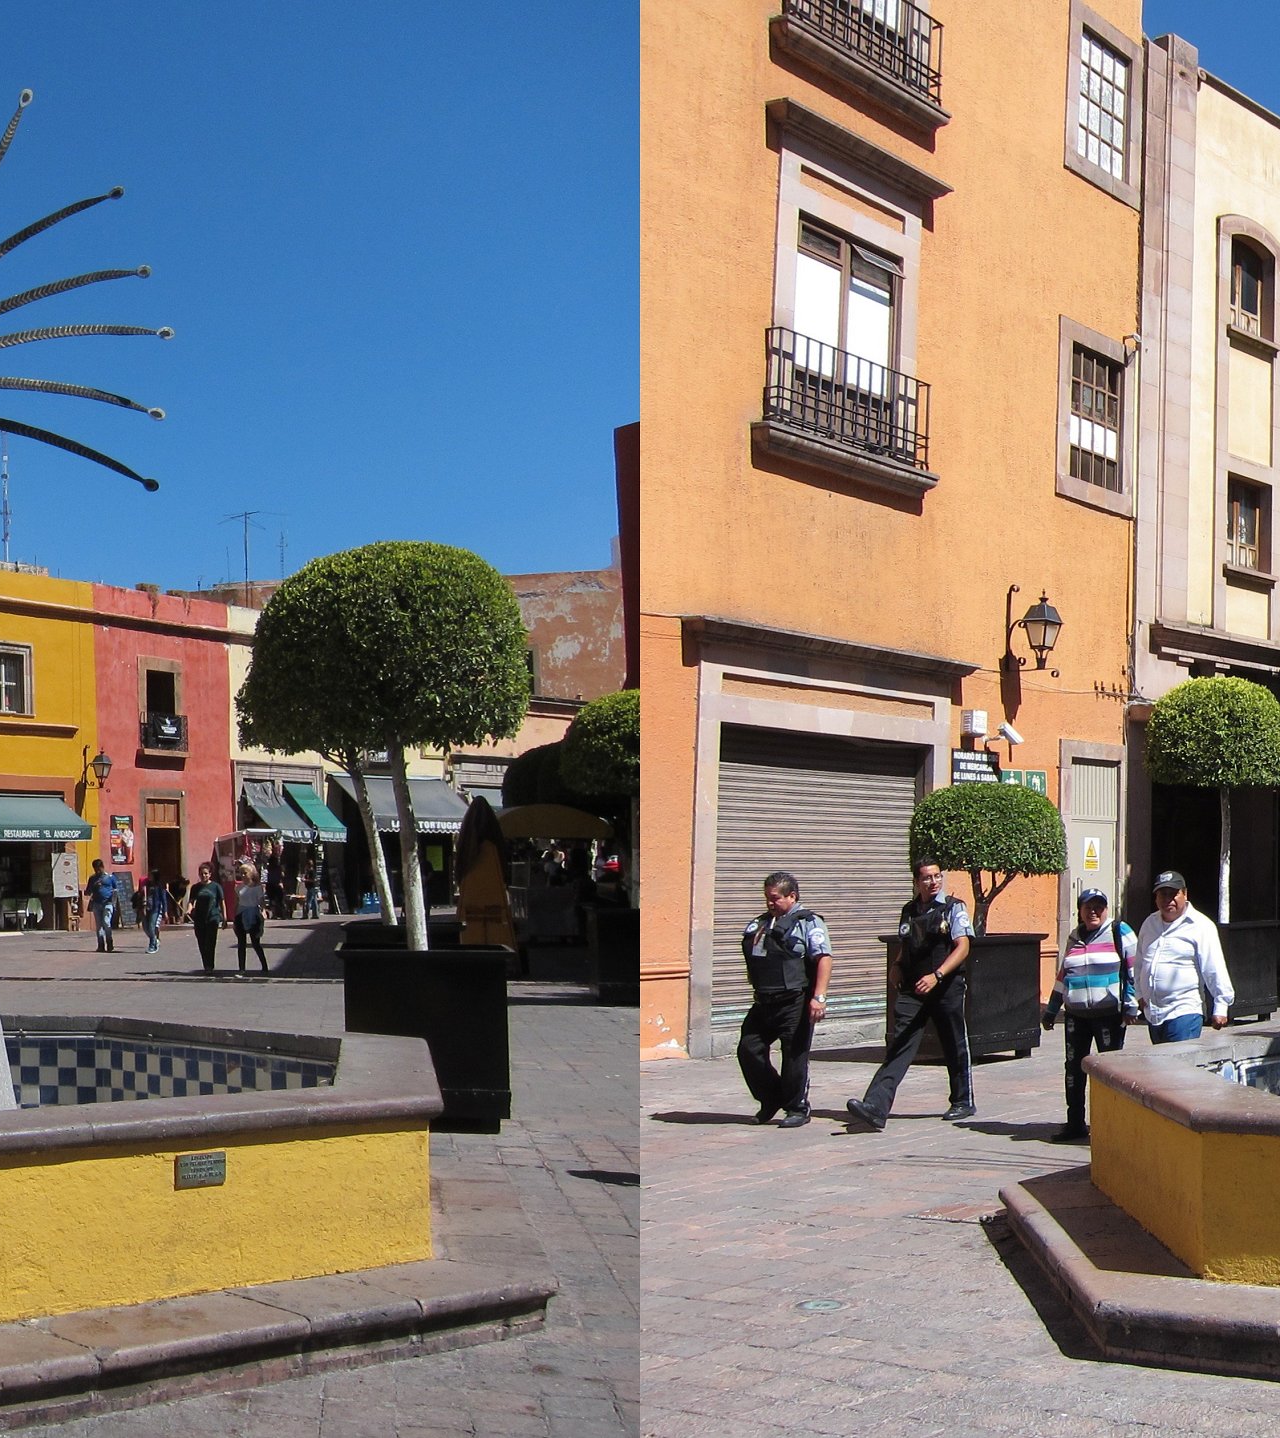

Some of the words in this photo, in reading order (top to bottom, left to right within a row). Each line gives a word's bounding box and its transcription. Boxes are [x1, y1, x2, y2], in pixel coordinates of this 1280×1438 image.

[975, 753, 981, 761] DE
[959, 762, 966, 770] DE
[953, 772, 961, 780] DE
[960, 772, 976, 780] LUNES
[417, 820, 463, 830] TORTUGAS
[3, 829, 40, 838] RESTAURANTE
